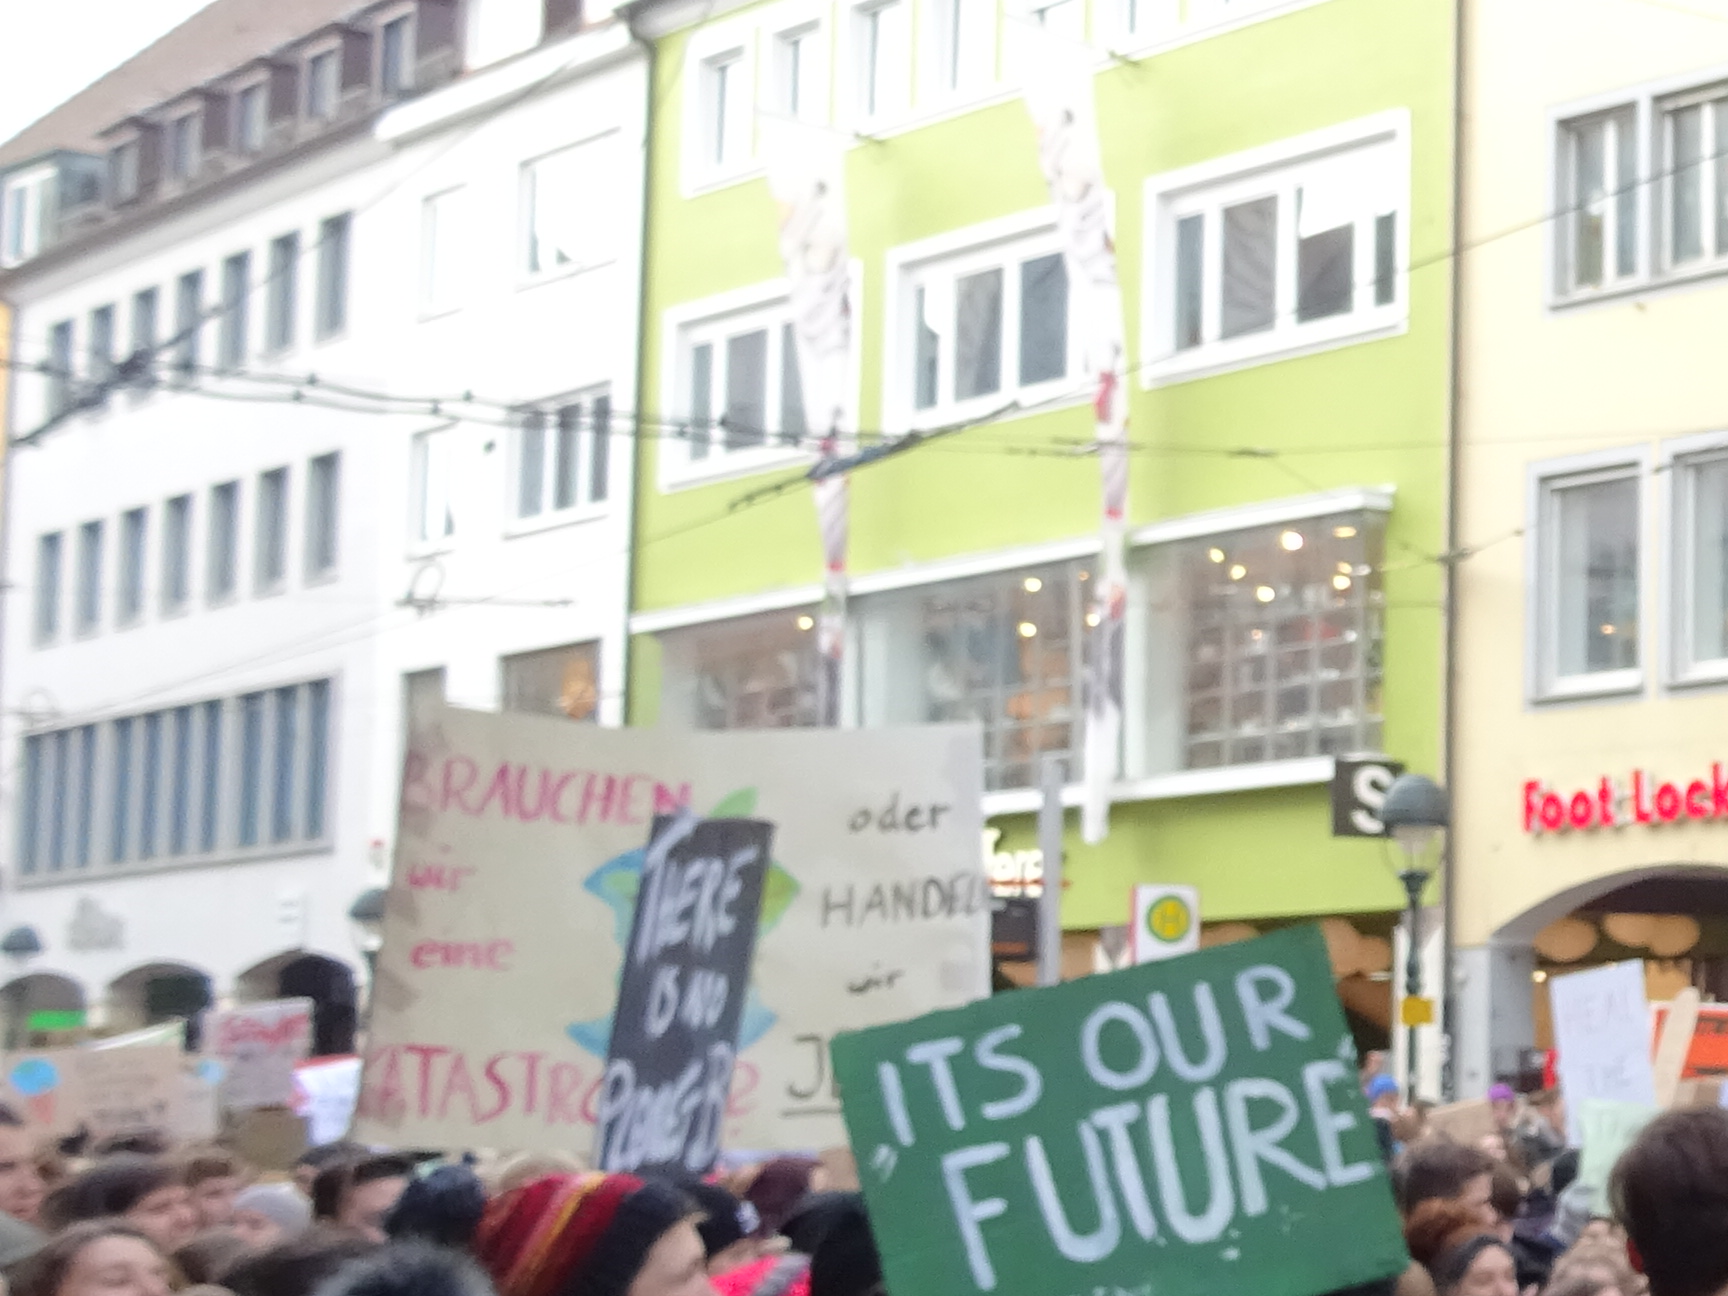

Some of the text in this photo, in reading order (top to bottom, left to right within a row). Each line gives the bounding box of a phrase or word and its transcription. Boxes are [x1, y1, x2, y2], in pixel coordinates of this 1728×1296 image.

[848, 790, 952, 834] oder
[1523, 775, 1616, 833] Foot
[405, 842, 476, 892] wir
[409, 936, 904, 995] eine wir
[1079, 963, 1312, 1092] OUR
